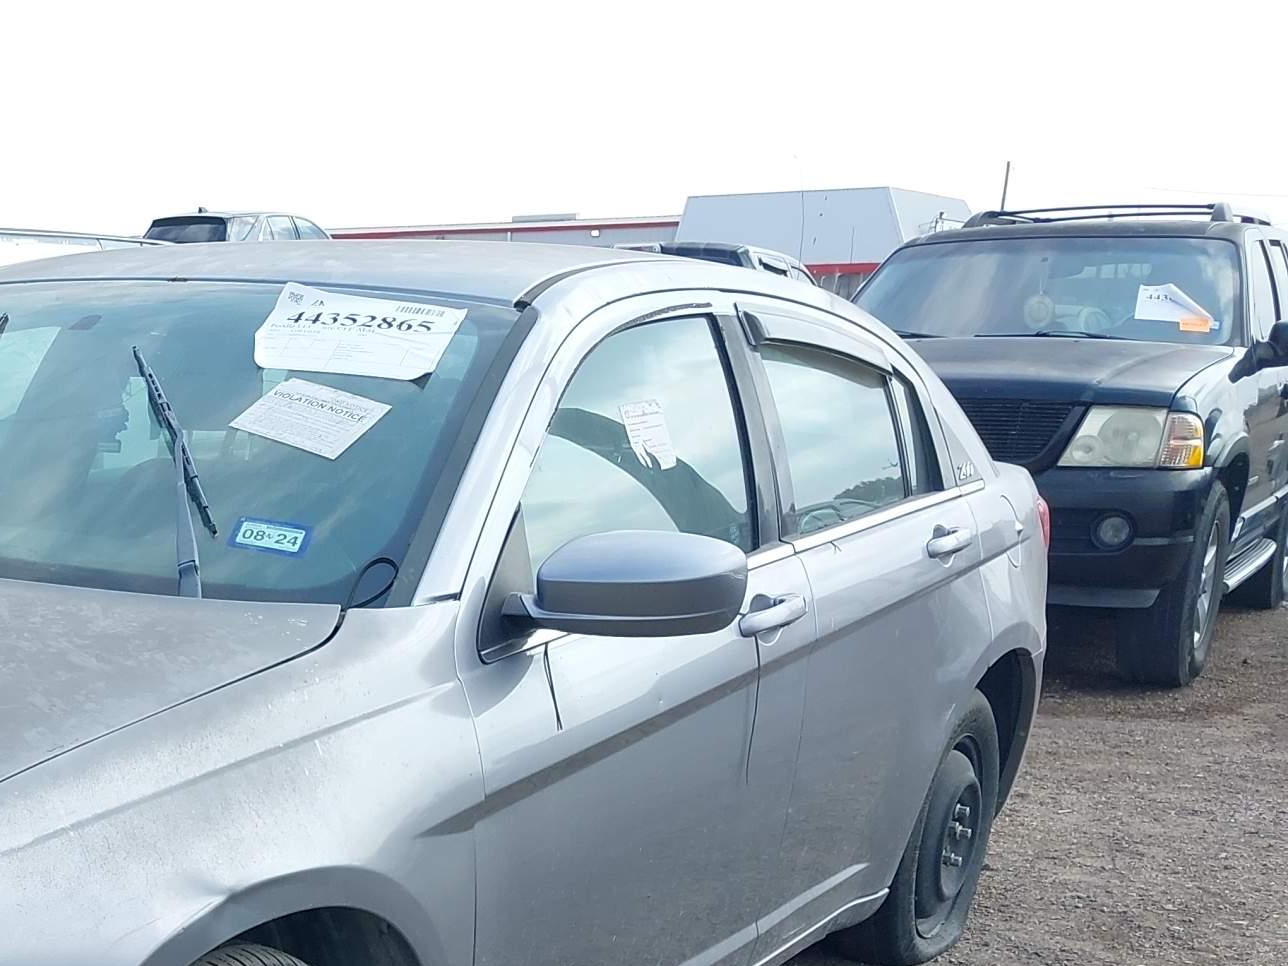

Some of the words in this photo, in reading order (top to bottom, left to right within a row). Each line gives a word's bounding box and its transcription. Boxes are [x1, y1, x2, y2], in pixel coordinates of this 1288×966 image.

[287, 311, 434, 333] 44352865
[273, 390, 329, 410] VIOLATION
[241, 528, 266, 542] 08
[274, 532, 300, 547] 24
